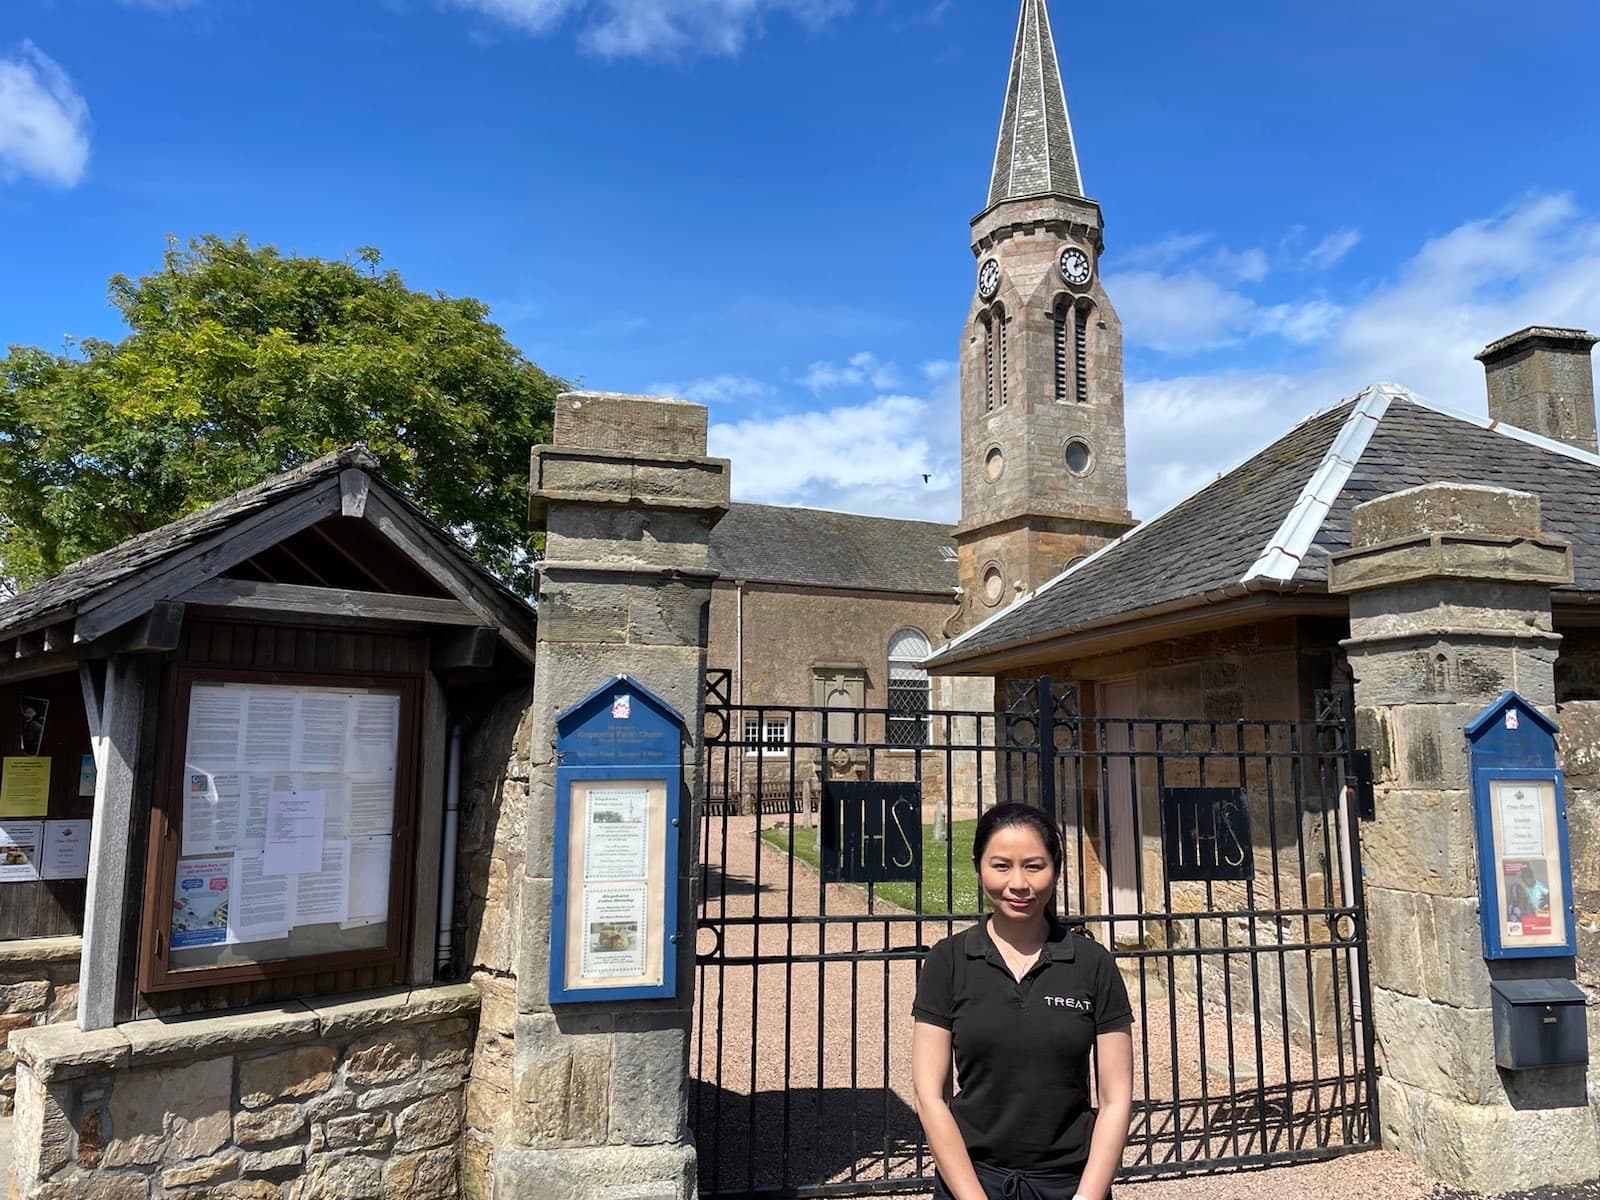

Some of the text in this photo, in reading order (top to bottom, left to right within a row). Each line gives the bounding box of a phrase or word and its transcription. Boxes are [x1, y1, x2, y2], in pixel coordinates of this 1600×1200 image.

[840, 799, 914, 869] IHS
[1177, 802, 1244, 867] IHS
[1043, 995, 1091, 1010] TREAT
